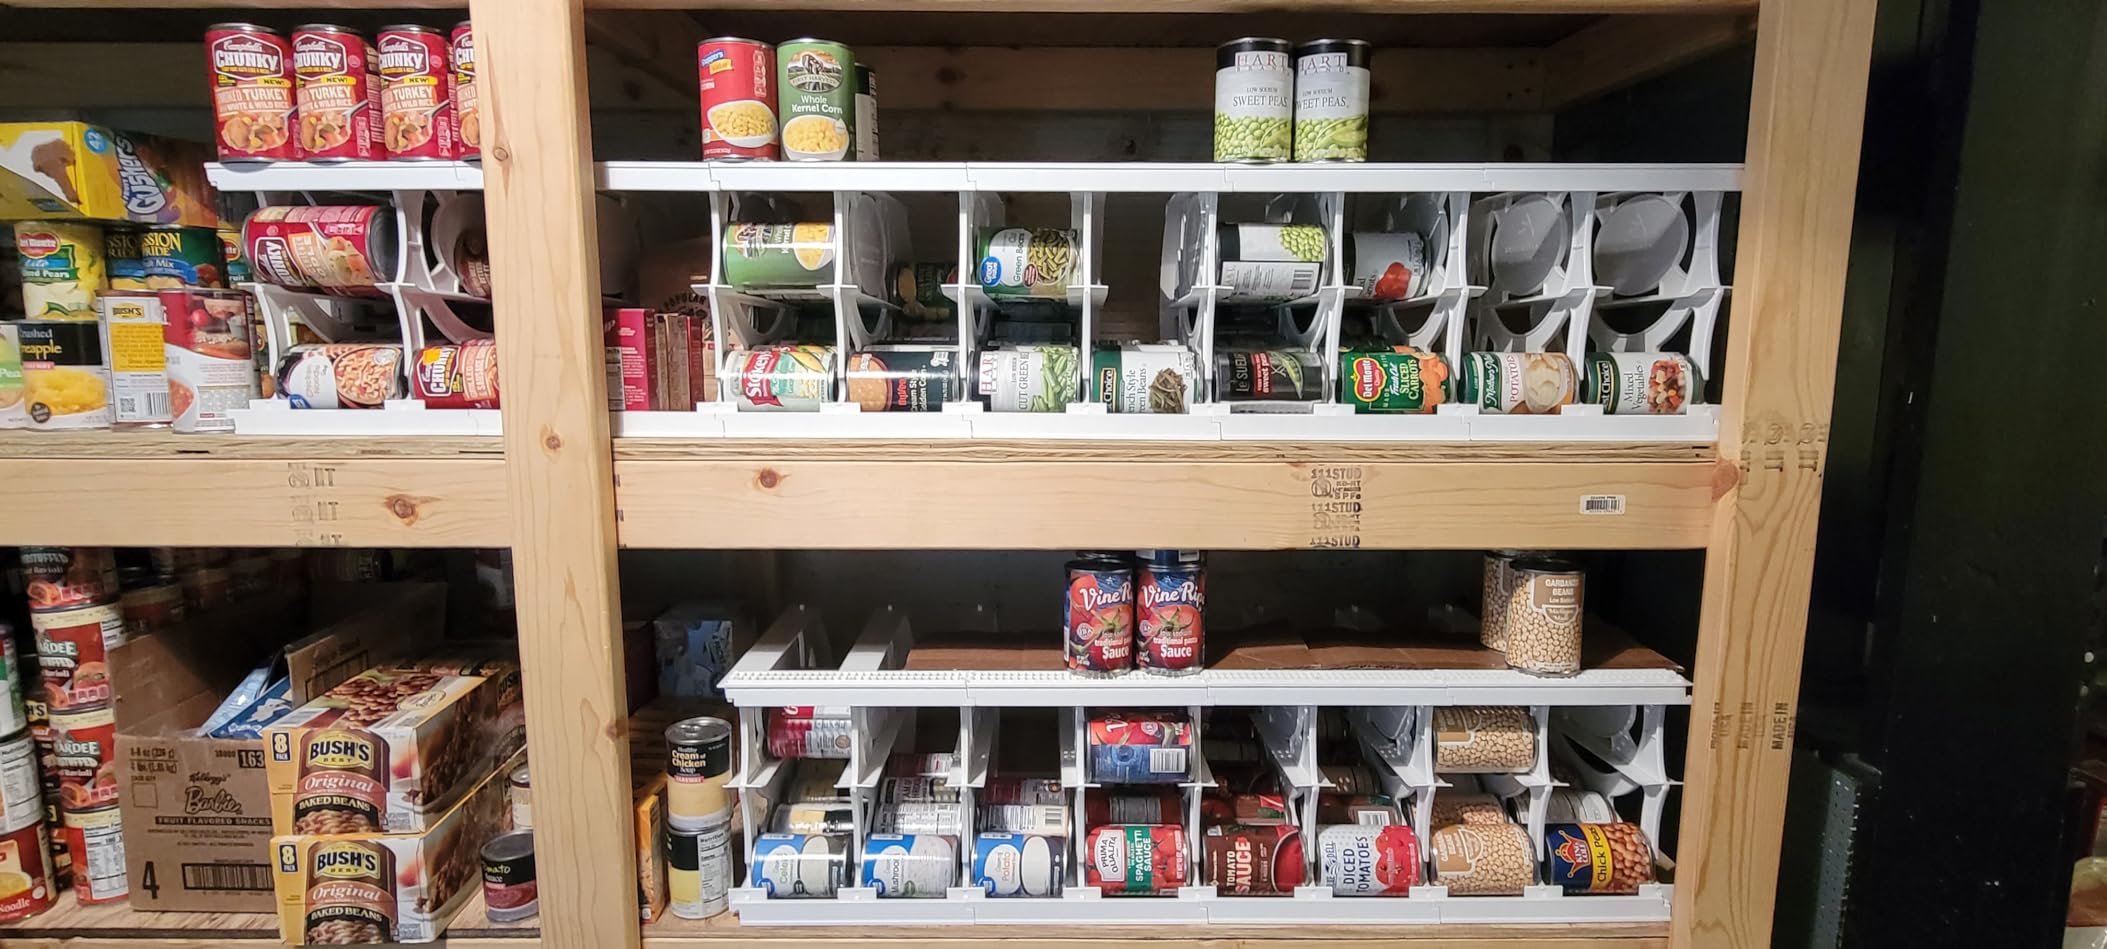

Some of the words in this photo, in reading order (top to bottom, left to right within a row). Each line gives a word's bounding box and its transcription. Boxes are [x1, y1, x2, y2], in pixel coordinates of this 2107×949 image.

[215, 50, 278, 71] CHUNKY
[1237, 54, 1288, 67] HART
[243, 88, 288, 101] TURKEY
[310, 86, 351, 100] TURKEY
[393, 85, 433, 100] TURKEY
[801, 95, 828, 104] Whole
[1233, 97, 1265, 107] SWEET
[1268, 96, 1288, 108] PEAS
[792, 104, 820, 112] Kernel
[821, 104, 843, 115] Corn
[1297, 99, 1319, 110] WEET
[1322, 97, 1346, 108] PEAS
[116, 136, 166, 214] Gushers
[147, 247, 171, 256] RIDE
[155, 259, 174, 268] Mix
[984, 262, 993, 283] Great
[1014, 256, 1022, 281] Green
[43, 270, 70, 278] Pears
[910, 369, 919, 388] Stye
[1019, 360, 1028, 389] GREEN
[1363, 360, 1373, 382] Monte
[1389, 362, 1399, 376] Cut
[1602, 363, 1610, 393] Choice
[1104, 371, 1112, 401] Choice
[1126, 370, 1138, 391] Style
[1137, 368, 1146, 394] Beans
[1363, 384, 1373, 397] Del
[1390, 376, 1400, 395] Fresh
[1624, 373, 1634, 401] Mixed
[1632, 365, 1646, 409] Vegetables
[1019, 391, 1027, 409] CUT
[1080, 588, 1121, 611] Vine
[1142, 585, 1179, 608] Vine
[1102, 646, 1129, 660] Sauce
[1160, 645, 1192, 658] Sauce
[27, 704, 46, 717] H'S
[1774, 703, 1788, 715] IN
[1771, 717, 1787, 750] MADE
[274, 734, 288, 754] 8
[310, 740, 369, 762] BUSH'S
[240, 751, 265, 767] 163
[672, 750, 699, 760] Cream
[672, 758, 706, 768] Chicken
[305, 774, 374, 793] Original
[185, 786, 241, 814] Barbie
[299, 796, 332, 810] BAKED
[332, 796, 371, 812] BEANS
[158, 817, 185, 825] FRUIT
[1589, 827, 1603, 848] Peas
[281, 846, 295, 864] 8
[318, 851, 376, 872] BUSH'S
[1100, 839, 1109, 868] PRIMA
[1135, 830, 1143, 881] SPAGHETTI
[891, 853, 899, 893] Mushroo
[1002, 852, 1011, 881] Potato
[1226, 851, 1235, 886] TOMATO
[1235, 840, 1252, 892] SAUCE
[1343, 848, 1355, 884] DICED
[1355, 836, 1371, 893] TOMATOES
[1598, 852, 1607, 882] Chick
[142, 861, 159, 899] 4
[312, 884, 380, 901] Original
[311, 907, 343, 921] BAKED
[345, 907, 382, 921] BEANS
